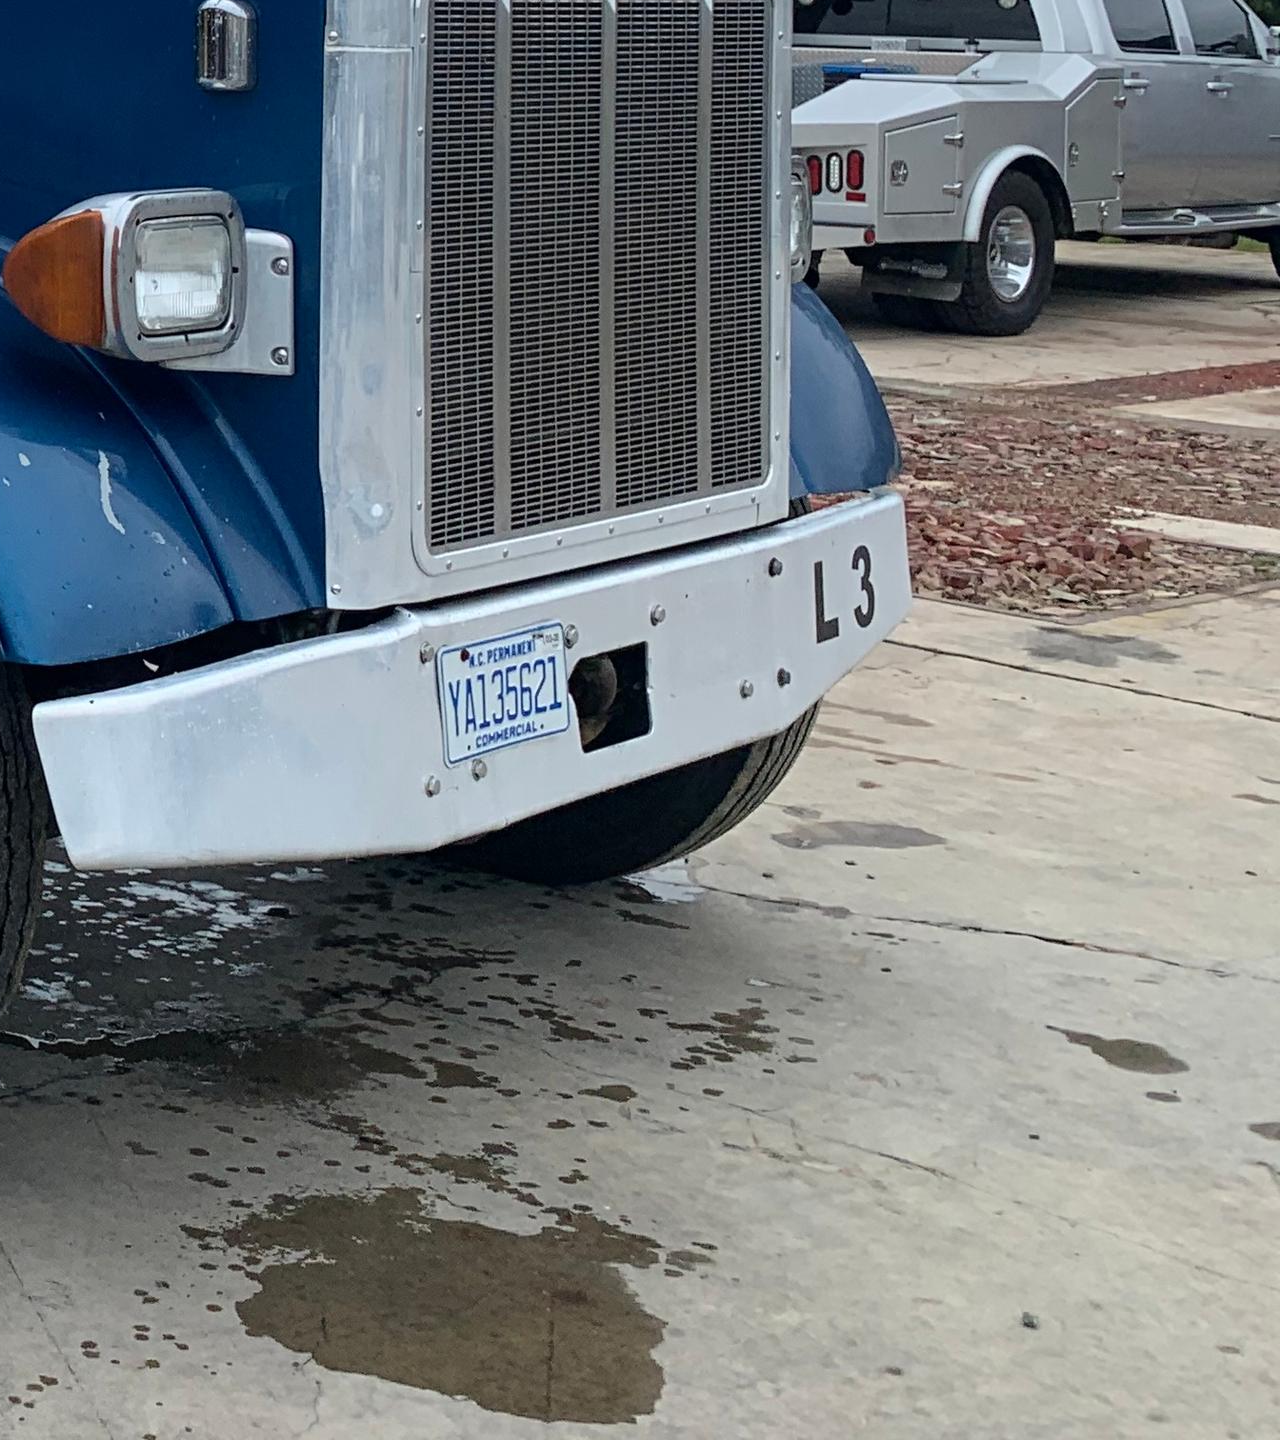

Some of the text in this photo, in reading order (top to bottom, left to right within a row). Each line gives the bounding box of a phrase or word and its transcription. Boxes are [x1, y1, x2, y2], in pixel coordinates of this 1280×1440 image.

[814, 545, 875, 644] L 3
[487, 639, 537, 663] PERMANENT
[449, 656, 562, 736] YA135621
[475, 721, 538, 748] COMMERCIAL
